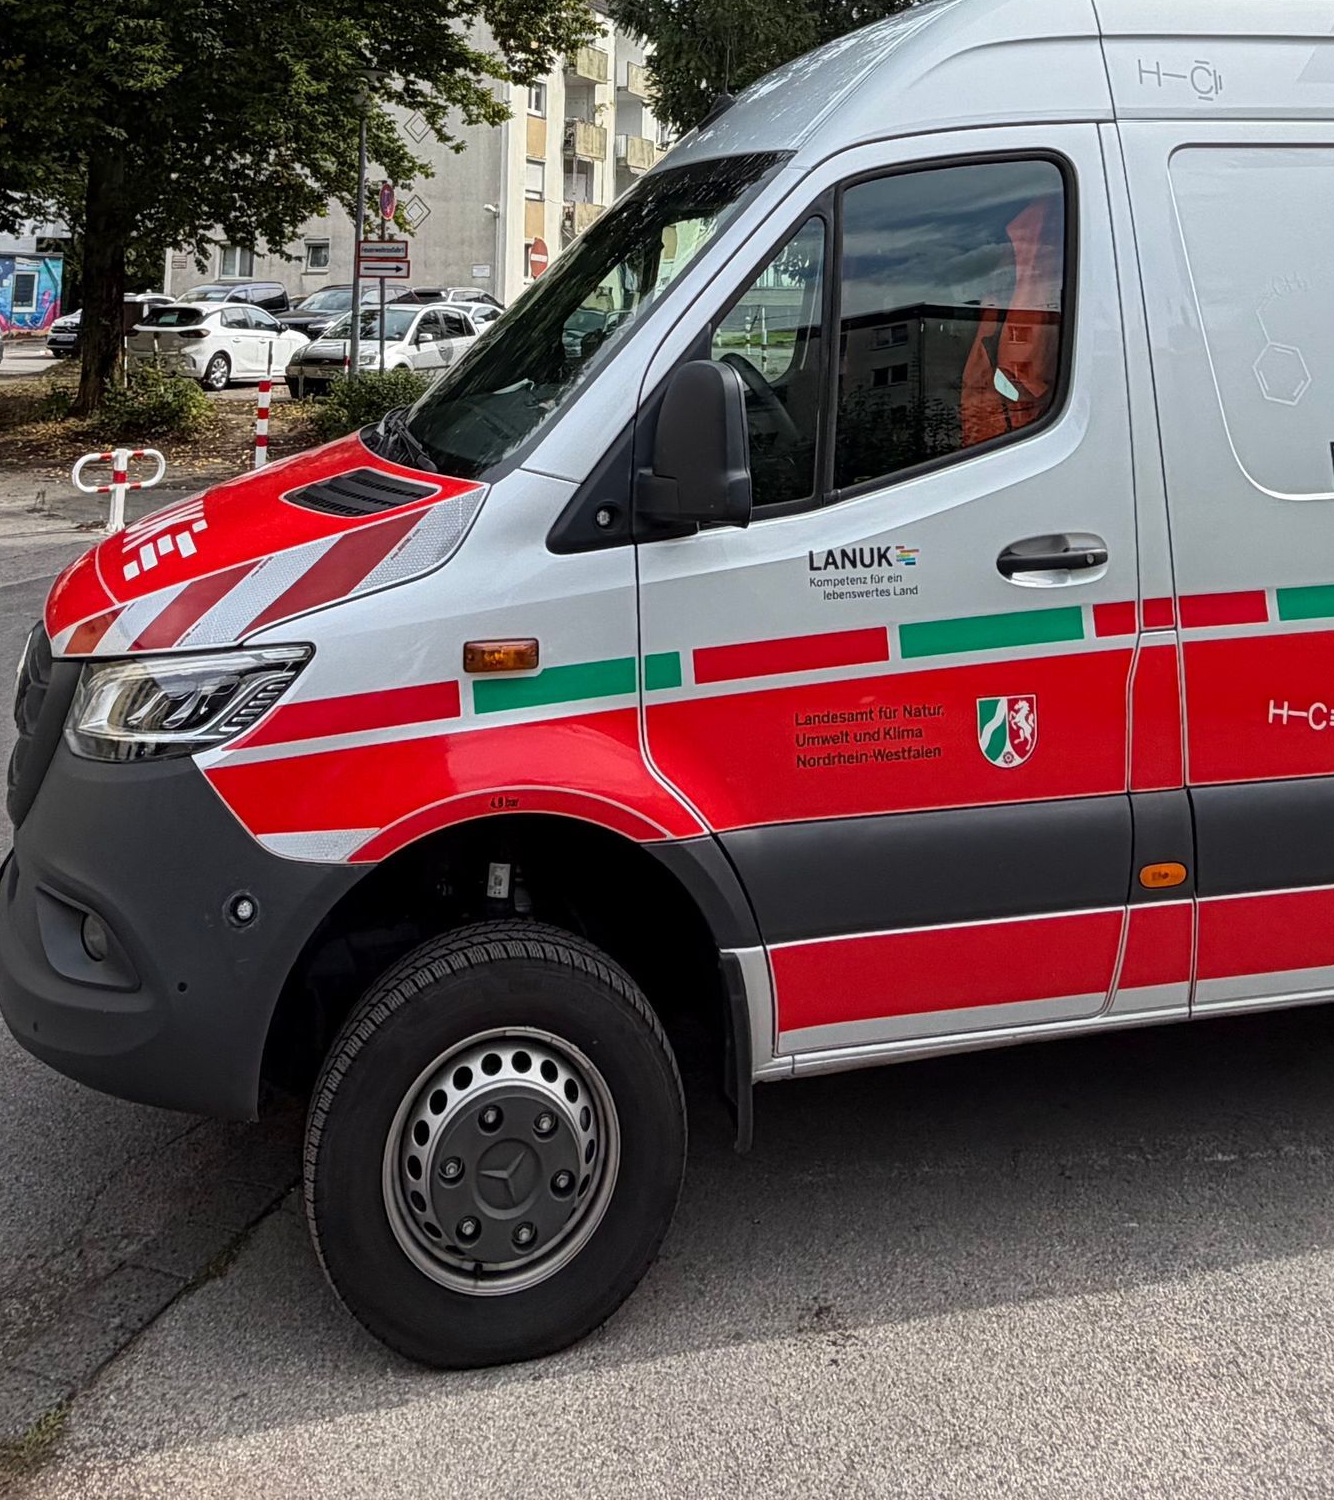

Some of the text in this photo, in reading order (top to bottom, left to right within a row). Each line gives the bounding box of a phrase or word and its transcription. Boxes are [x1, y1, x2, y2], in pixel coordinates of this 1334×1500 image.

[808, 546, 893, 571] LANUK
[809, 573, 903, 588] Kompetenz für ein
[823, 585, 919, 600] lebenswertes Land
[795, 707, 875, 726] Landesamt
[879, 706, 899, 720] für
[795, 726, 923, 748] Umwelt und Klima
[796, 745, 942, 769] Nordrhein-Westfalen
